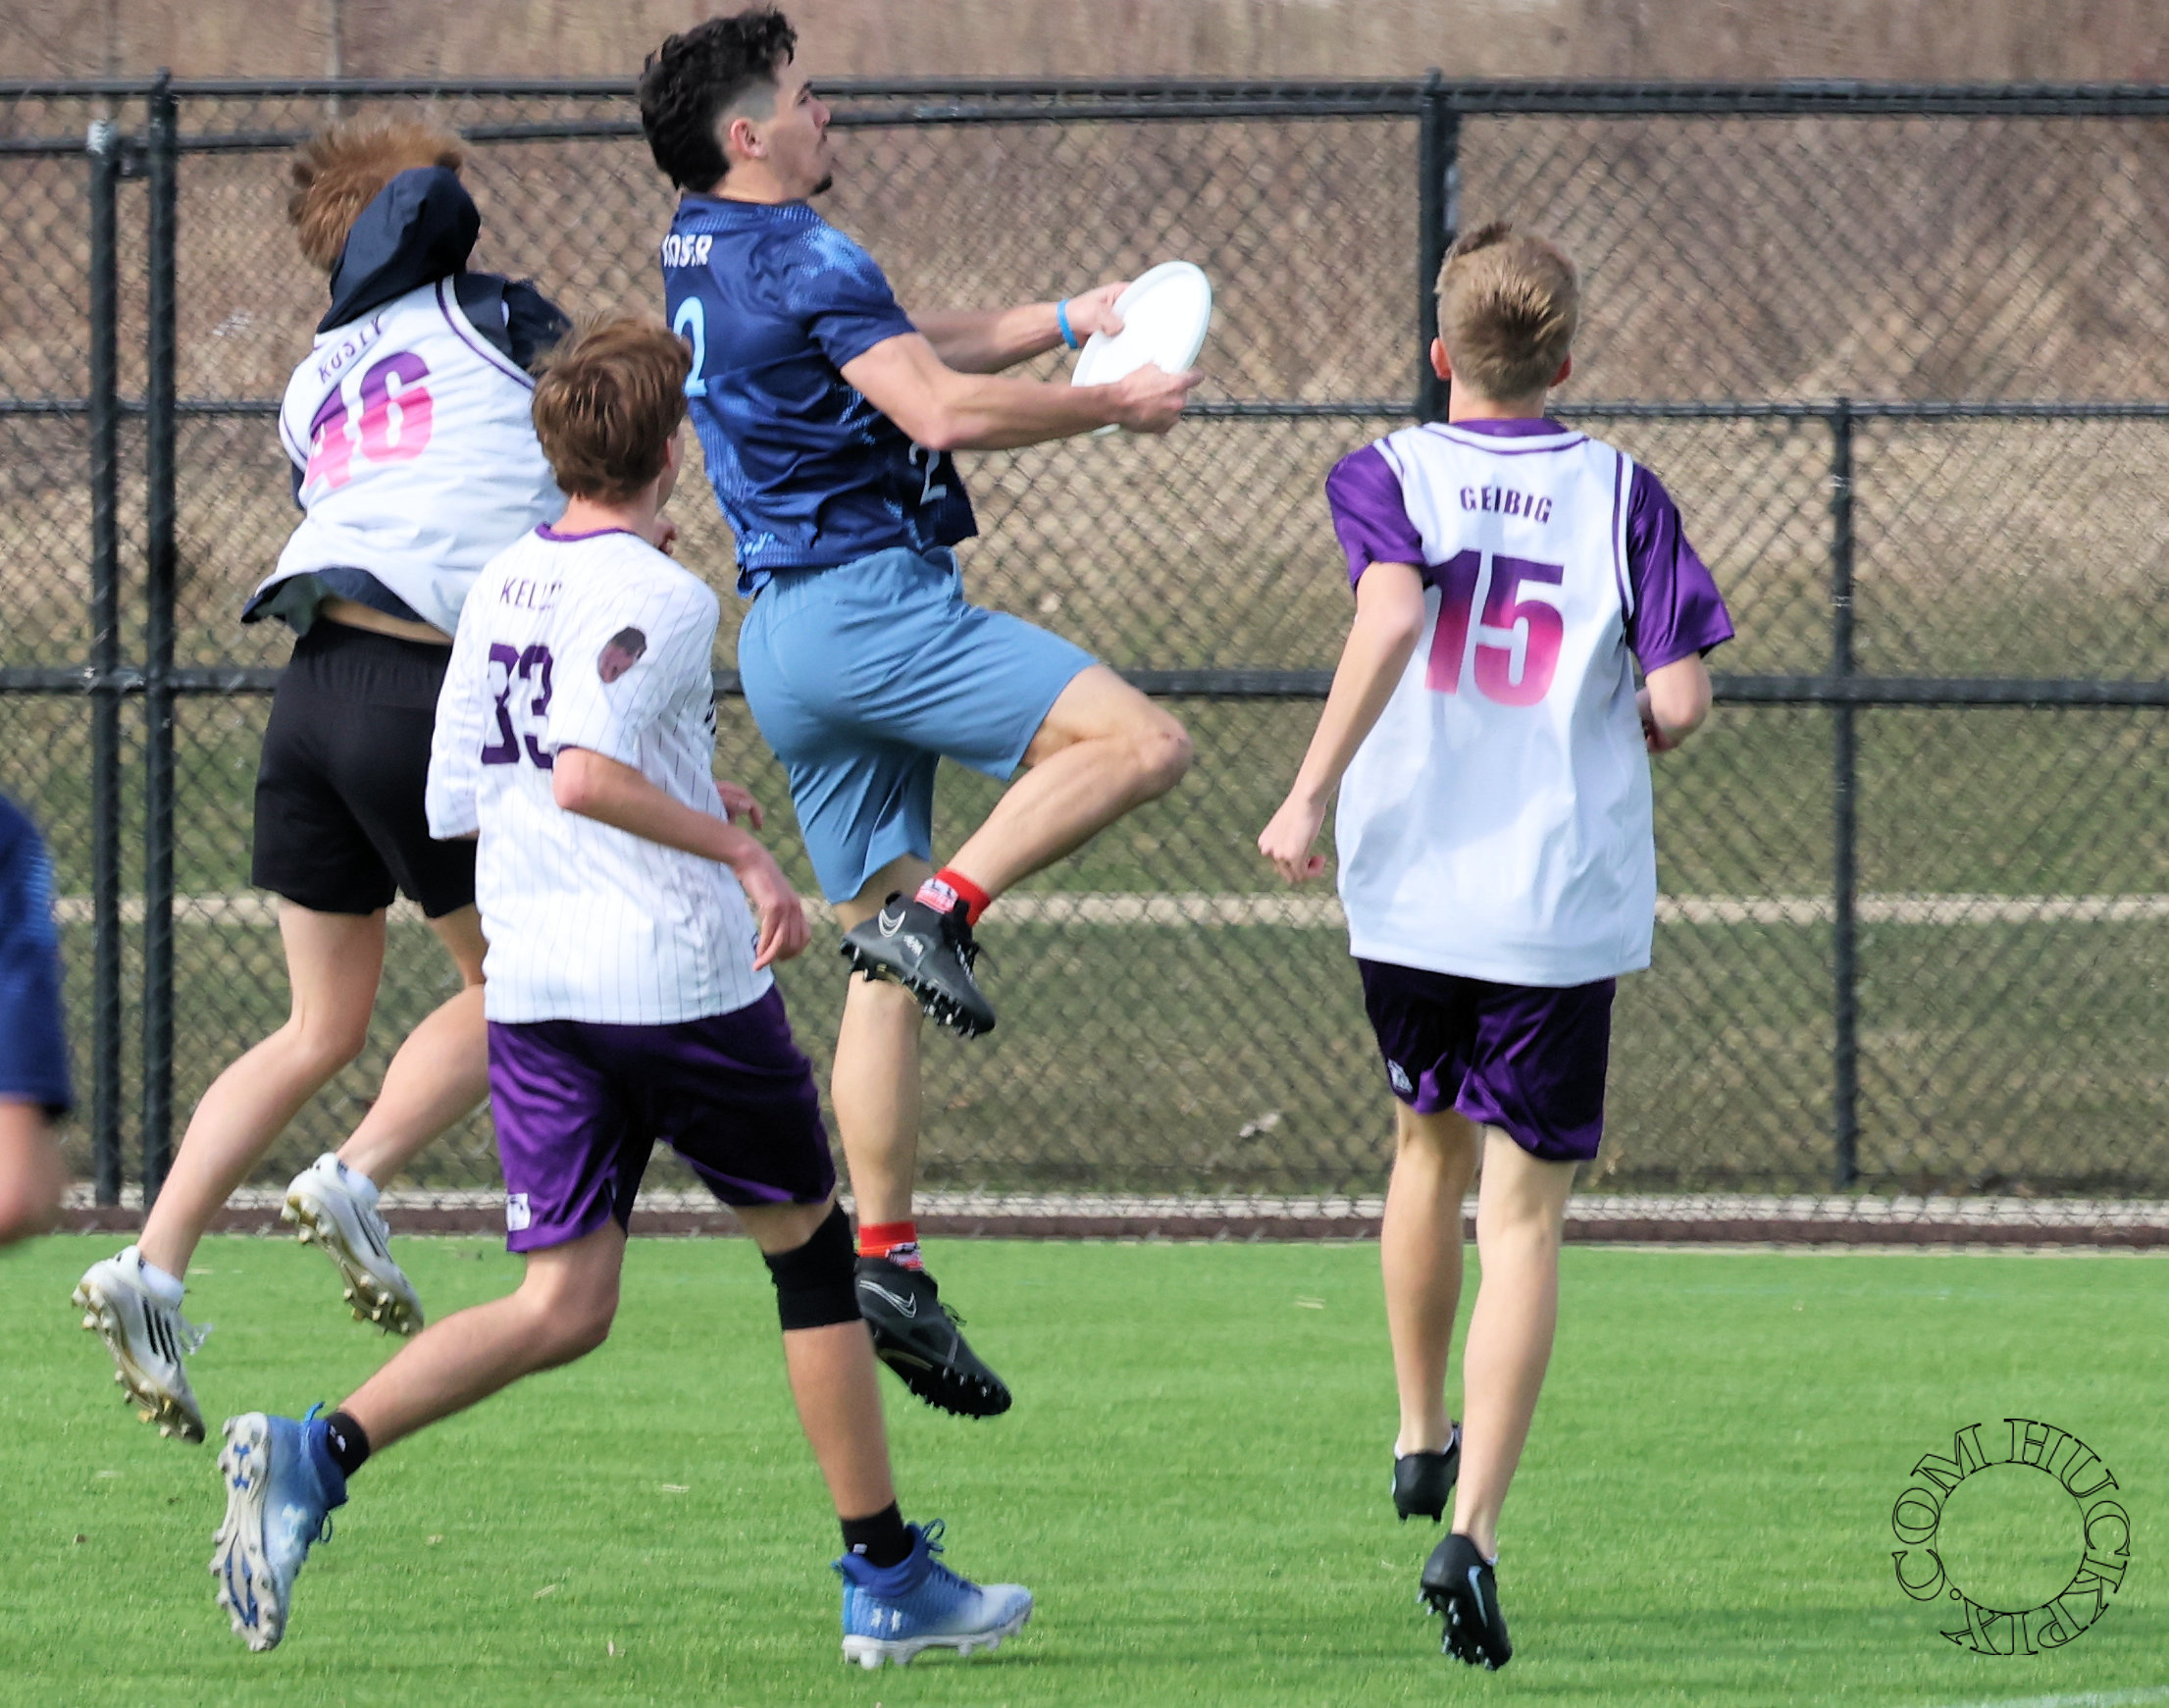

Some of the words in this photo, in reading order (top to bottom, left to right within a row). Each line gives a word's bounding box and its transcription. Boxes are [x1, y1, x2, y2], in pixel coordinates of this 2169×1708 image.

[908, 443, 947, 506] 2
[1460, 486, 1553, 524] GEIBIG
[1423, 548, 1565, 708] 15
